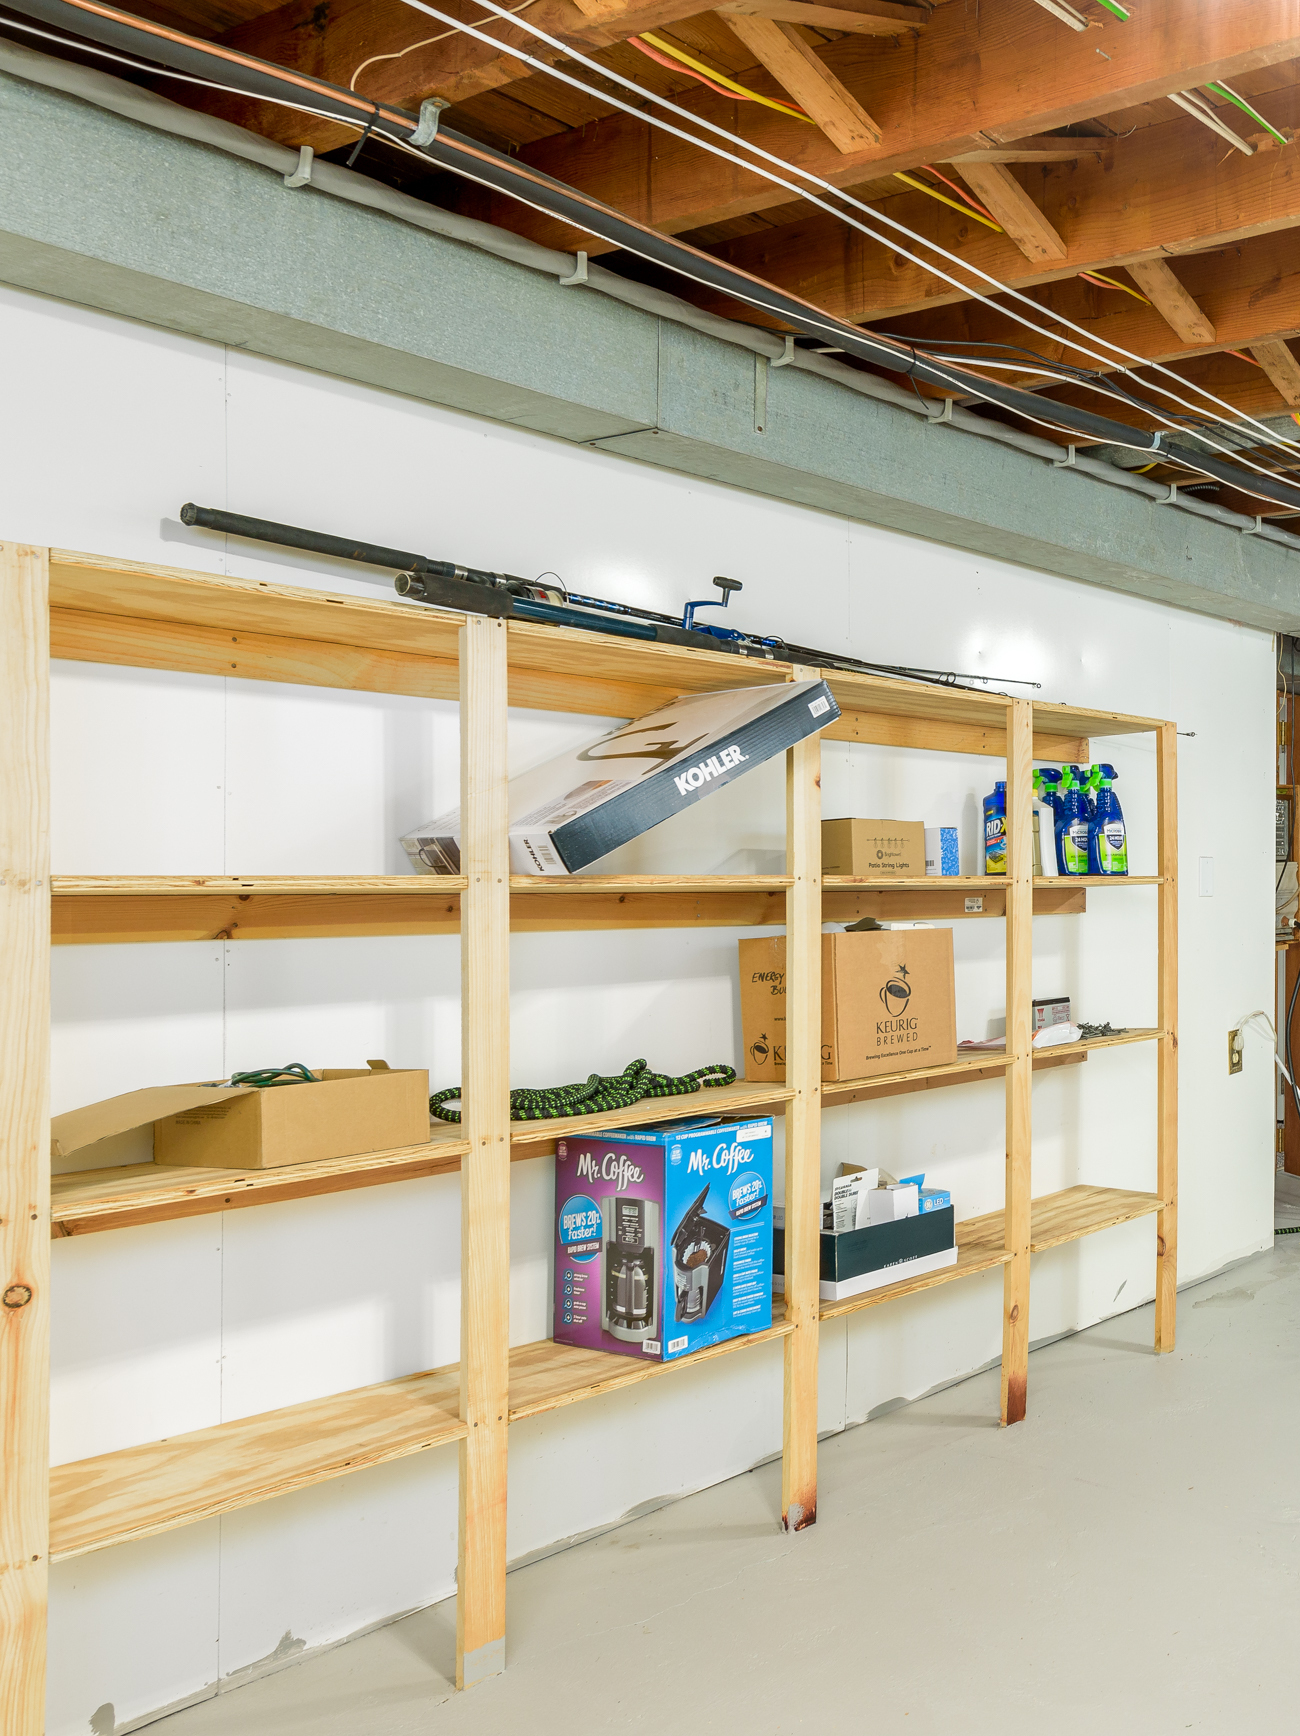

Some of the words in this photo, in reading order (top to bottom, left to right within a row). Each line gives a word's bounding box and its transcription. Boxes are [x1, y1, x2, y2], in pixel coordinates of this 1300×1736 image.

[881, 862, 895, 870] String
[896, 862, 910, 870] Lights
[876, 1017, 918, 1035] KEURIG
[876, 1032, 918, 1047] BREWED
[686, 1148, 711, 1176] Mr.
[712, 1142, 755, 1176] Coffee
[577, 1152, 601, 1183] Mr.
[601, 1152, 645, 1192] Coffee
[732, 1183, 752, 1201] BREWS
[933, 1197, 944, 1206] LED
[563, 1212, 586, 1230] BREWS
[568, 1223, 598, 1240] faster!
